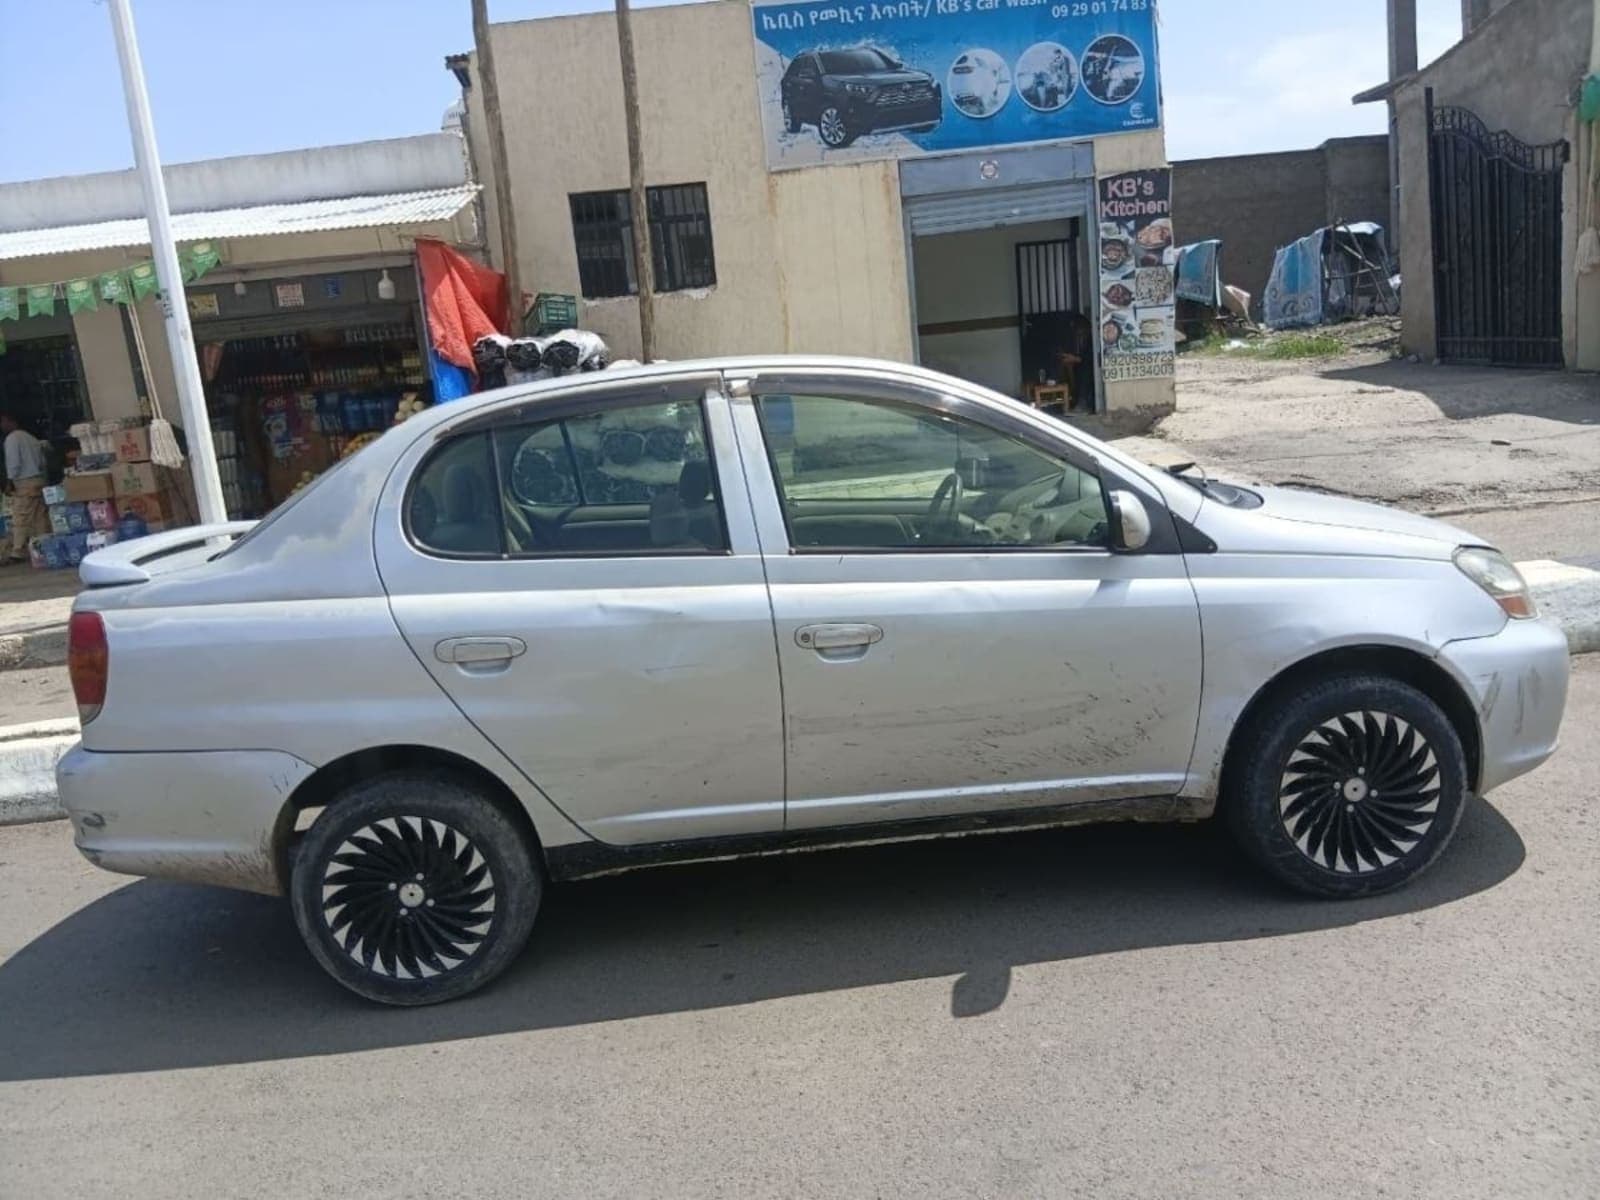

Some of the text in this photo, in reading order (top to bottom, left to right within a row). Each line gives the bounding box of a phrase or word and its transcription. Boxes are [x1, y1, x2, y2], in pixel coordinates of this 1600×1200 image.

[809, 6, 865, 25] የመኪና
[1052, 4, 1068, 18] 09
[1072, 2, 1088, 16] 29
[1091, 1, 1107, 14] 01
[1111, 0, 1128, 12] 74
[1108, 177, 1154, 198] KB's
[1101, 199, 1168, 218] Kitchen
